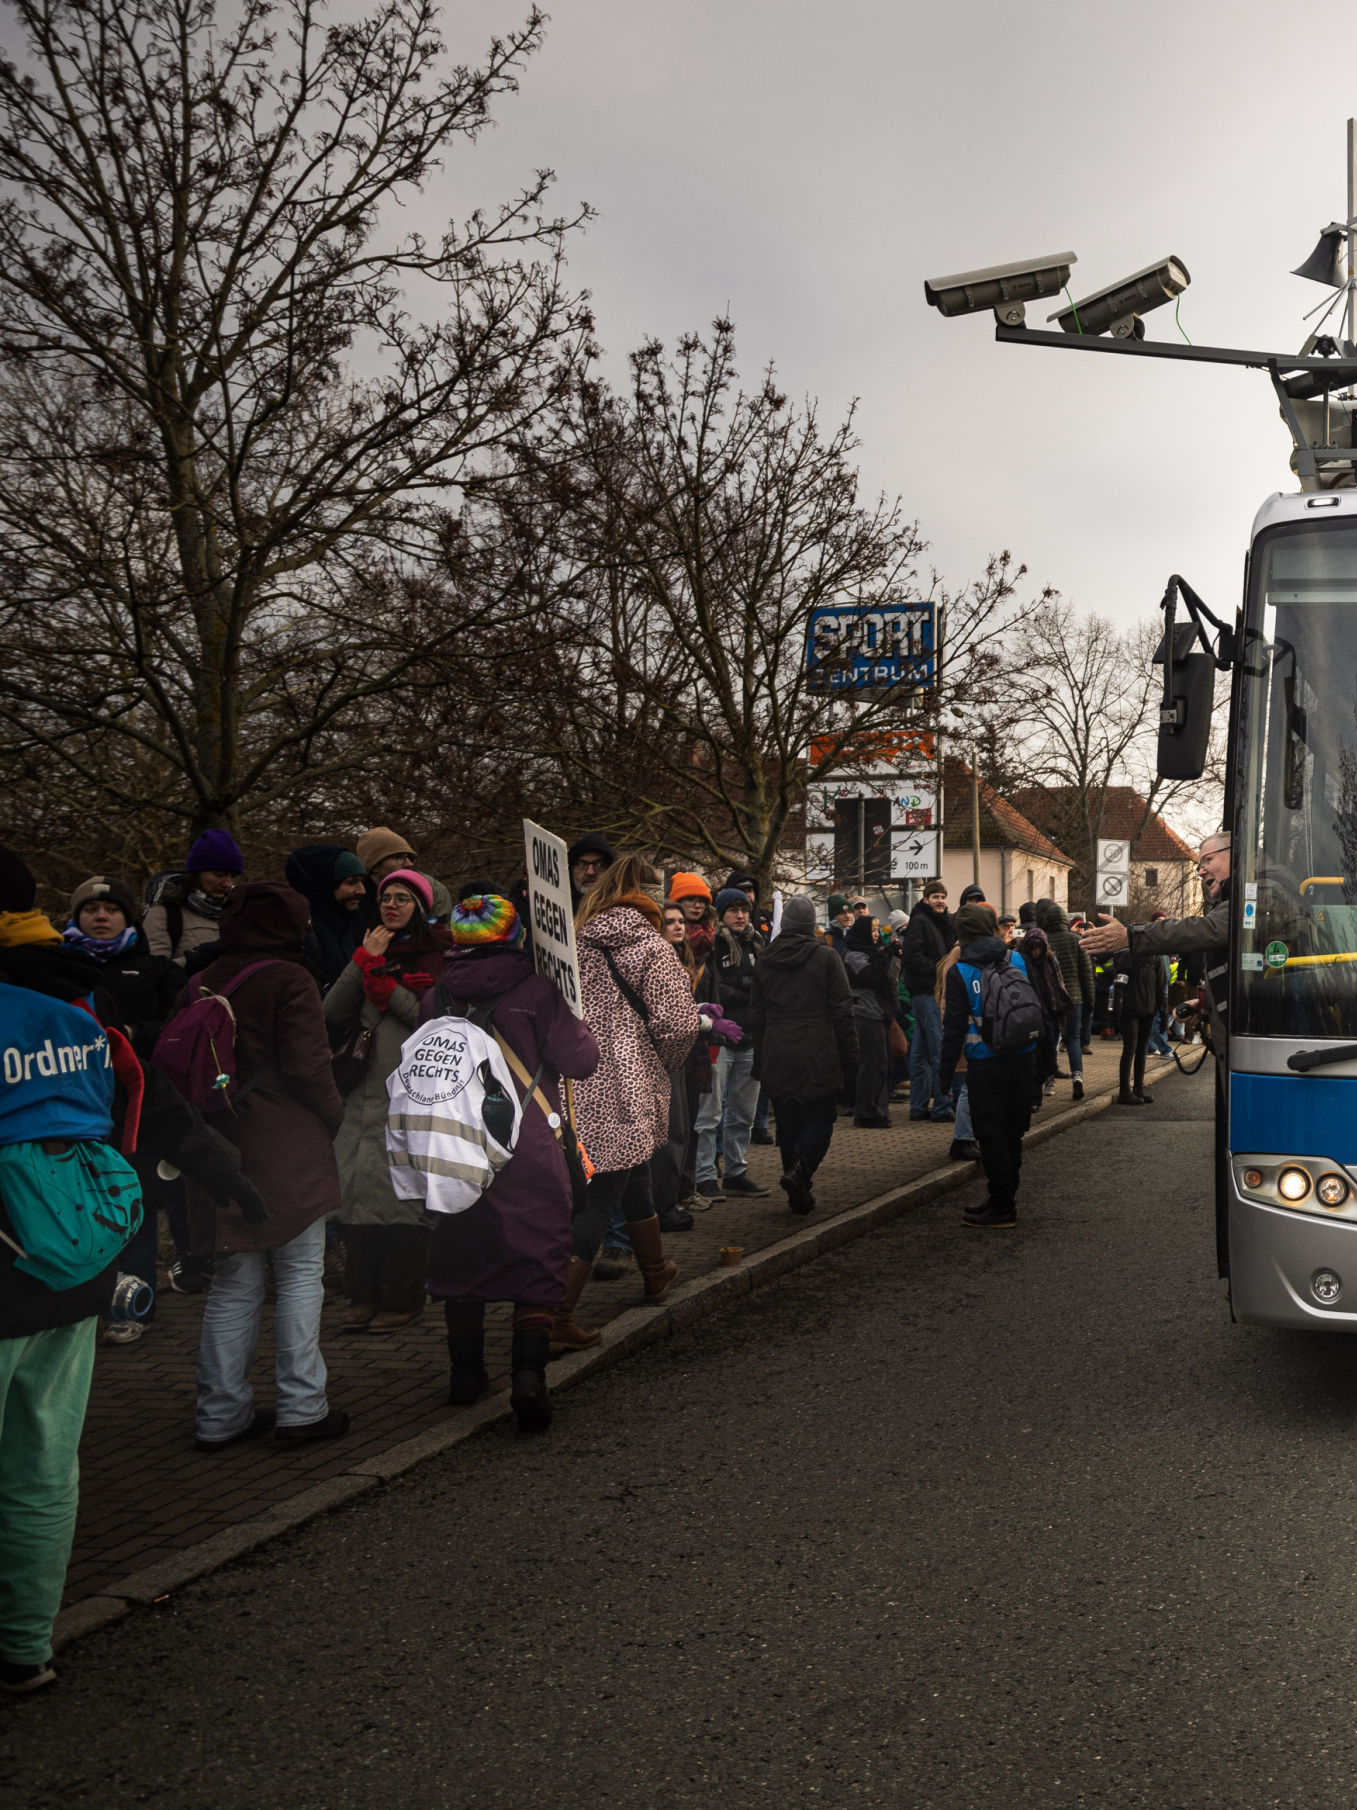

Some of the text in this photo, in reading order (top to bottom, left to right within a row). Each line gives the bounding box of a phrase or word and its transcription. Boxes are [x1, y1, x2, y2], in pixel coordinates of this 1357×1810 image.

[814, 611, 929, 660] SPORT
[533, 836, 560, 889] OMAS
[905, 861, 919, 870] 100
[534, 890, 568, 947] GEGEN
[535, 942, 577, 1003] RECHTS
[414, 1048, 462, 1066] GEGEN
[422, 1036, 466, 1053] OMAS
[409, 1064, 460, 1083] RECHTS
